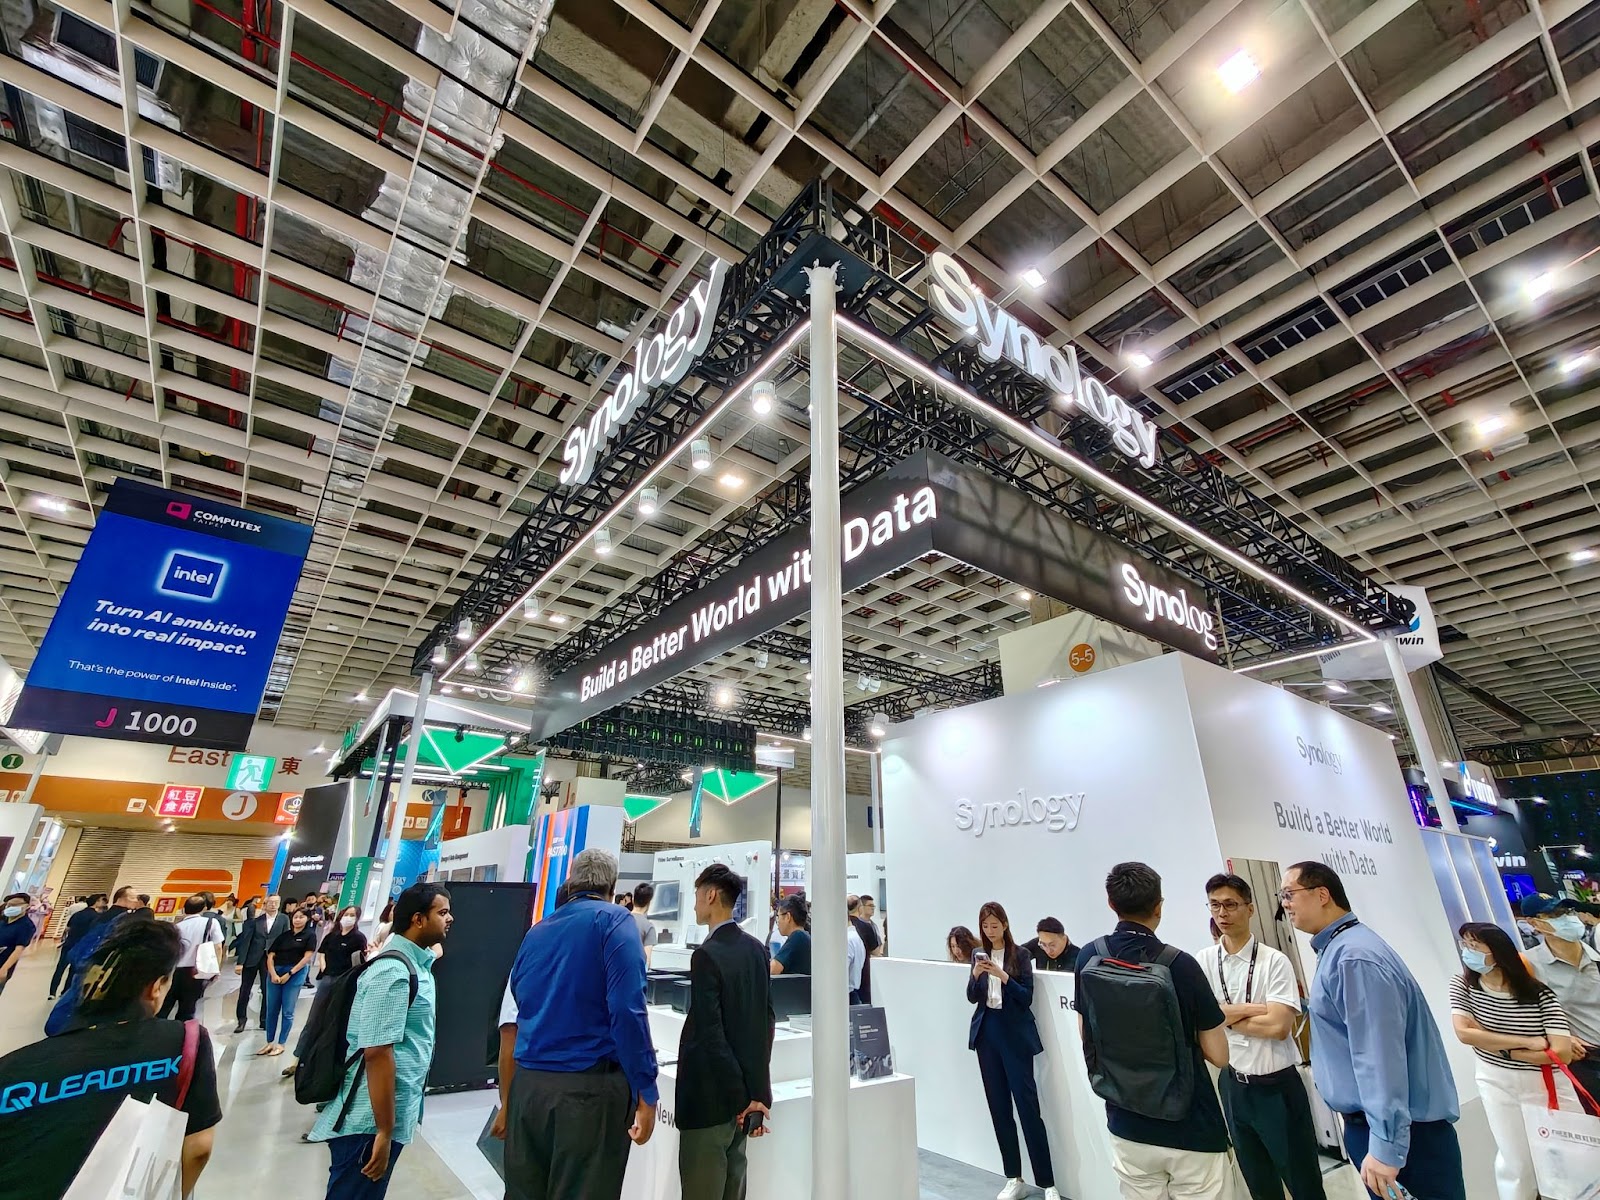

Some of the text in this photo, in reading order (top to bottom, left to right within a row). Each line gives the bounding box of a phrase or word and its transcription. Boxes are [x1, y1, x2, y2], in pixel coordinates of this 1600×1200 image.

[560, 257, 728, 486] Synology
[929, 251, 1157, 470] Synology
[194, 510, 262, 532] COMPUTEX
[173, 566, 214, 585] intel
[580, 486, 937, 703] Build a Better World wit Data
[1121, 563, 1217, 650] Synolog
[95, 599, 257, 640] Turn AI ambition
[86, 618, 248, 656] into real impact.
[1396, 634, 1424, 645] win
[1071, 648, 1094, 667] 5-5
[68, 660, 103, 673] That's
[105, 666, 125, 676] the
[125, 670, 161, 682] power
[162, 674, 175, 683] of
[175, 675, 200, 687] Intel
[95, 707, 197, 737] J 1000
[168, 745, 230, 767] East
[277, 756, 302, 775] 東
[1296, 735, 1343, 775] Synology
[162, 801, 194, 814] 食府
[166, 789, 199, 802] 紅豆
[230, 795, 249, 816] J
[424, 790, 433, 801] K
[954, 787, 1086, 838] Synology
[1274, 801, 1394, 844] Build a Better World
[1321, 848, 1378, 876] with Data
[1494, 852, 1526, 867] win
[351, 862, 363, 889] Growth
[1060, 995, 1075, 1010] Re
[38, 1055, 182, 1104] LEADTEK
[656, 1103, 675, 1128] New
